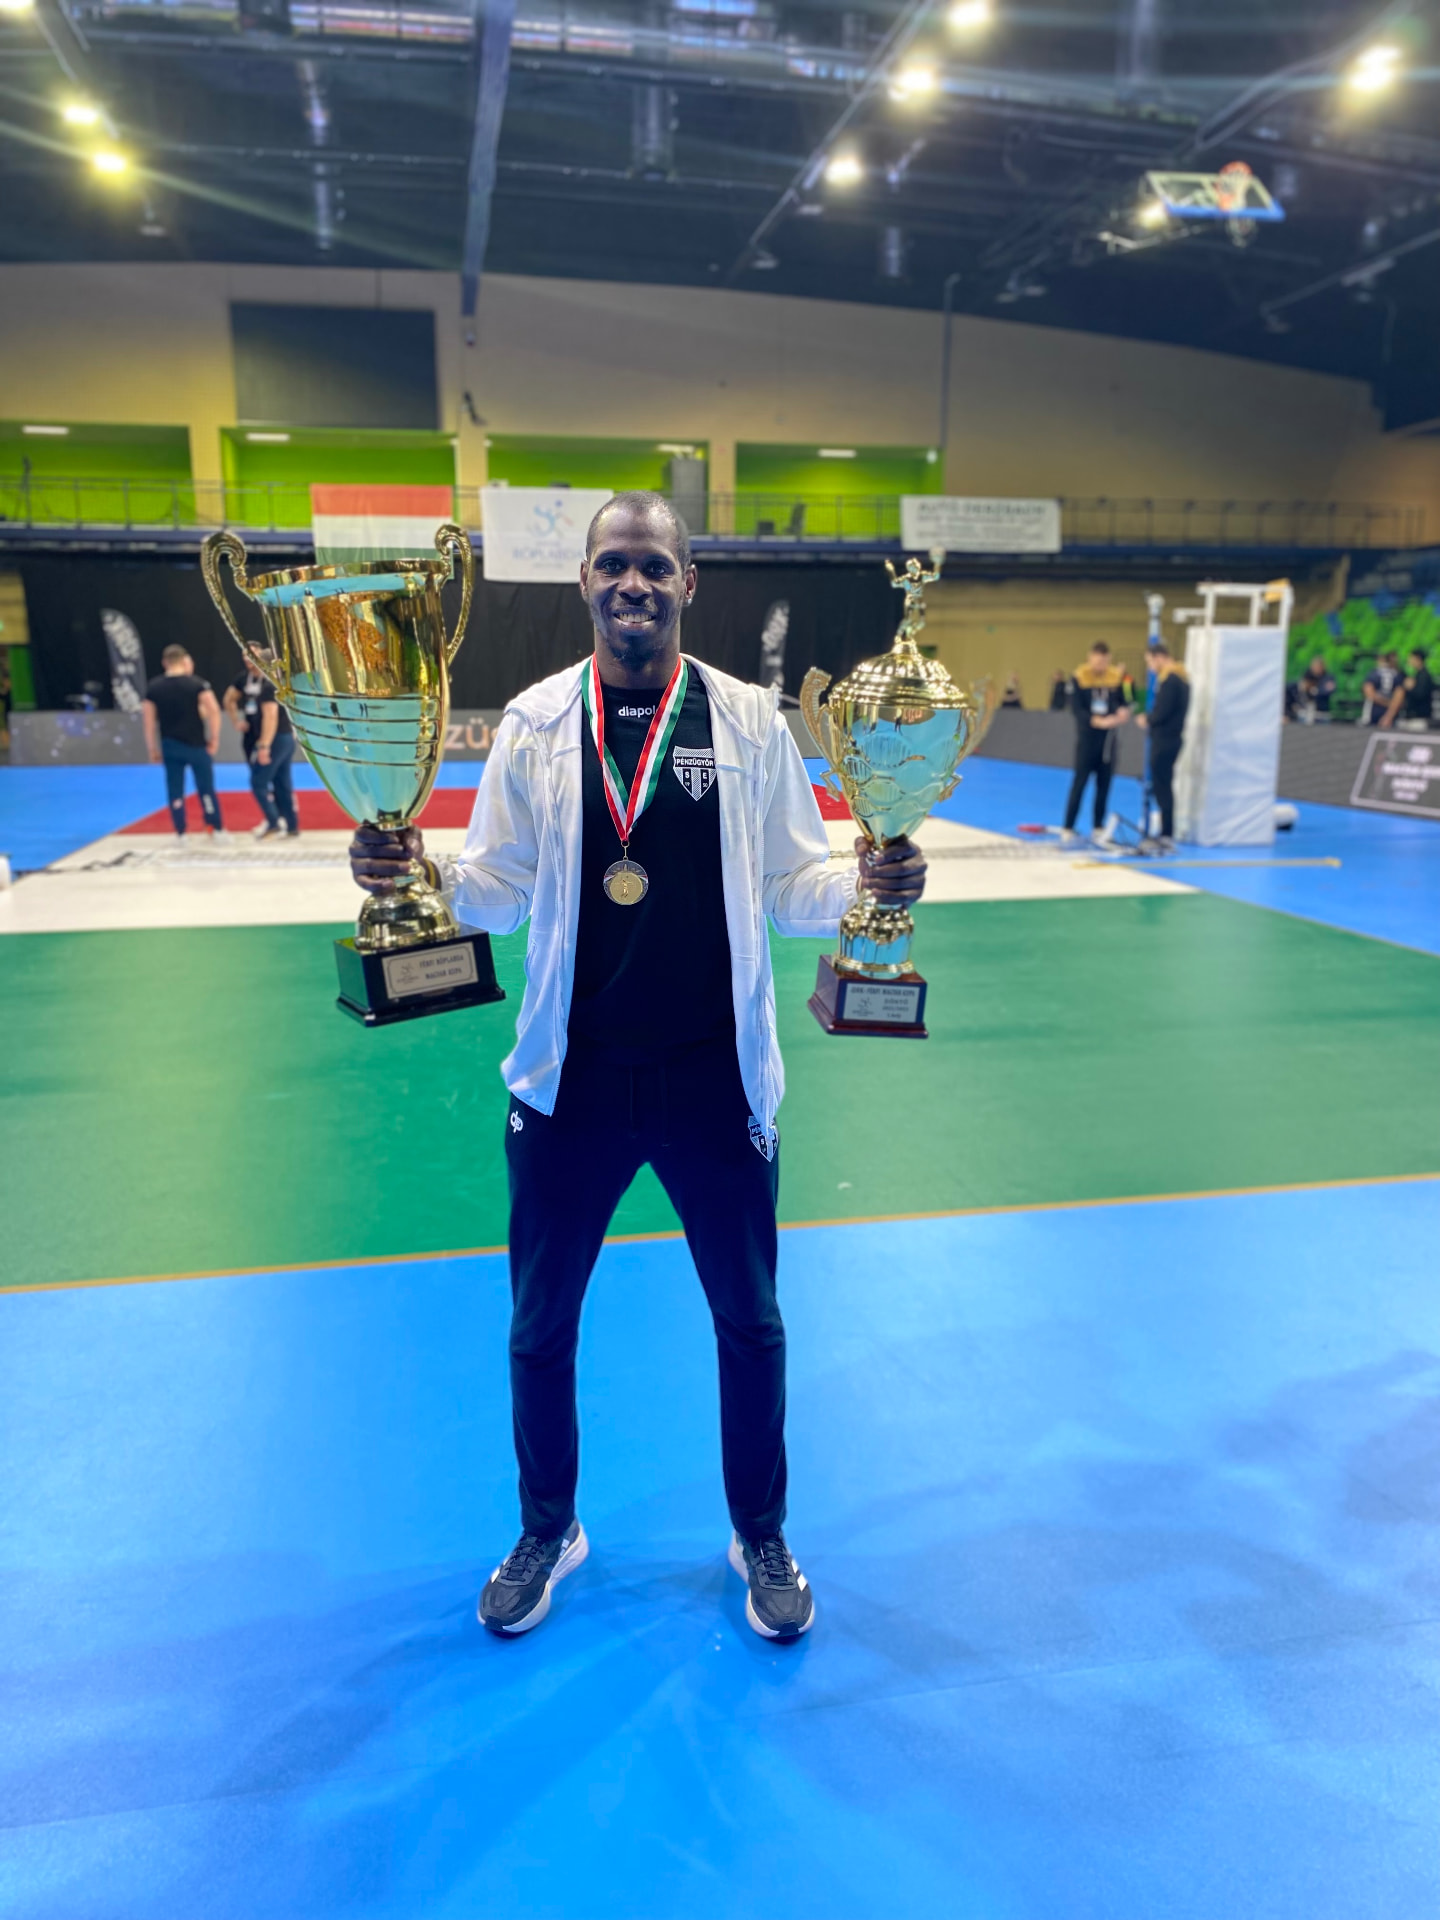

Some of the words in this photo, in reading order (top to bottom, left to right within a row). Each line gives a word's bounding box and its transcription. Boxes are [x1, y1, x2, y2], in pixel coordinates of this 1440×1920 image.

[618, 705, 657, 718] diapol
[684, 771, 690, 779] S
[702, 772, 708, 780] E
